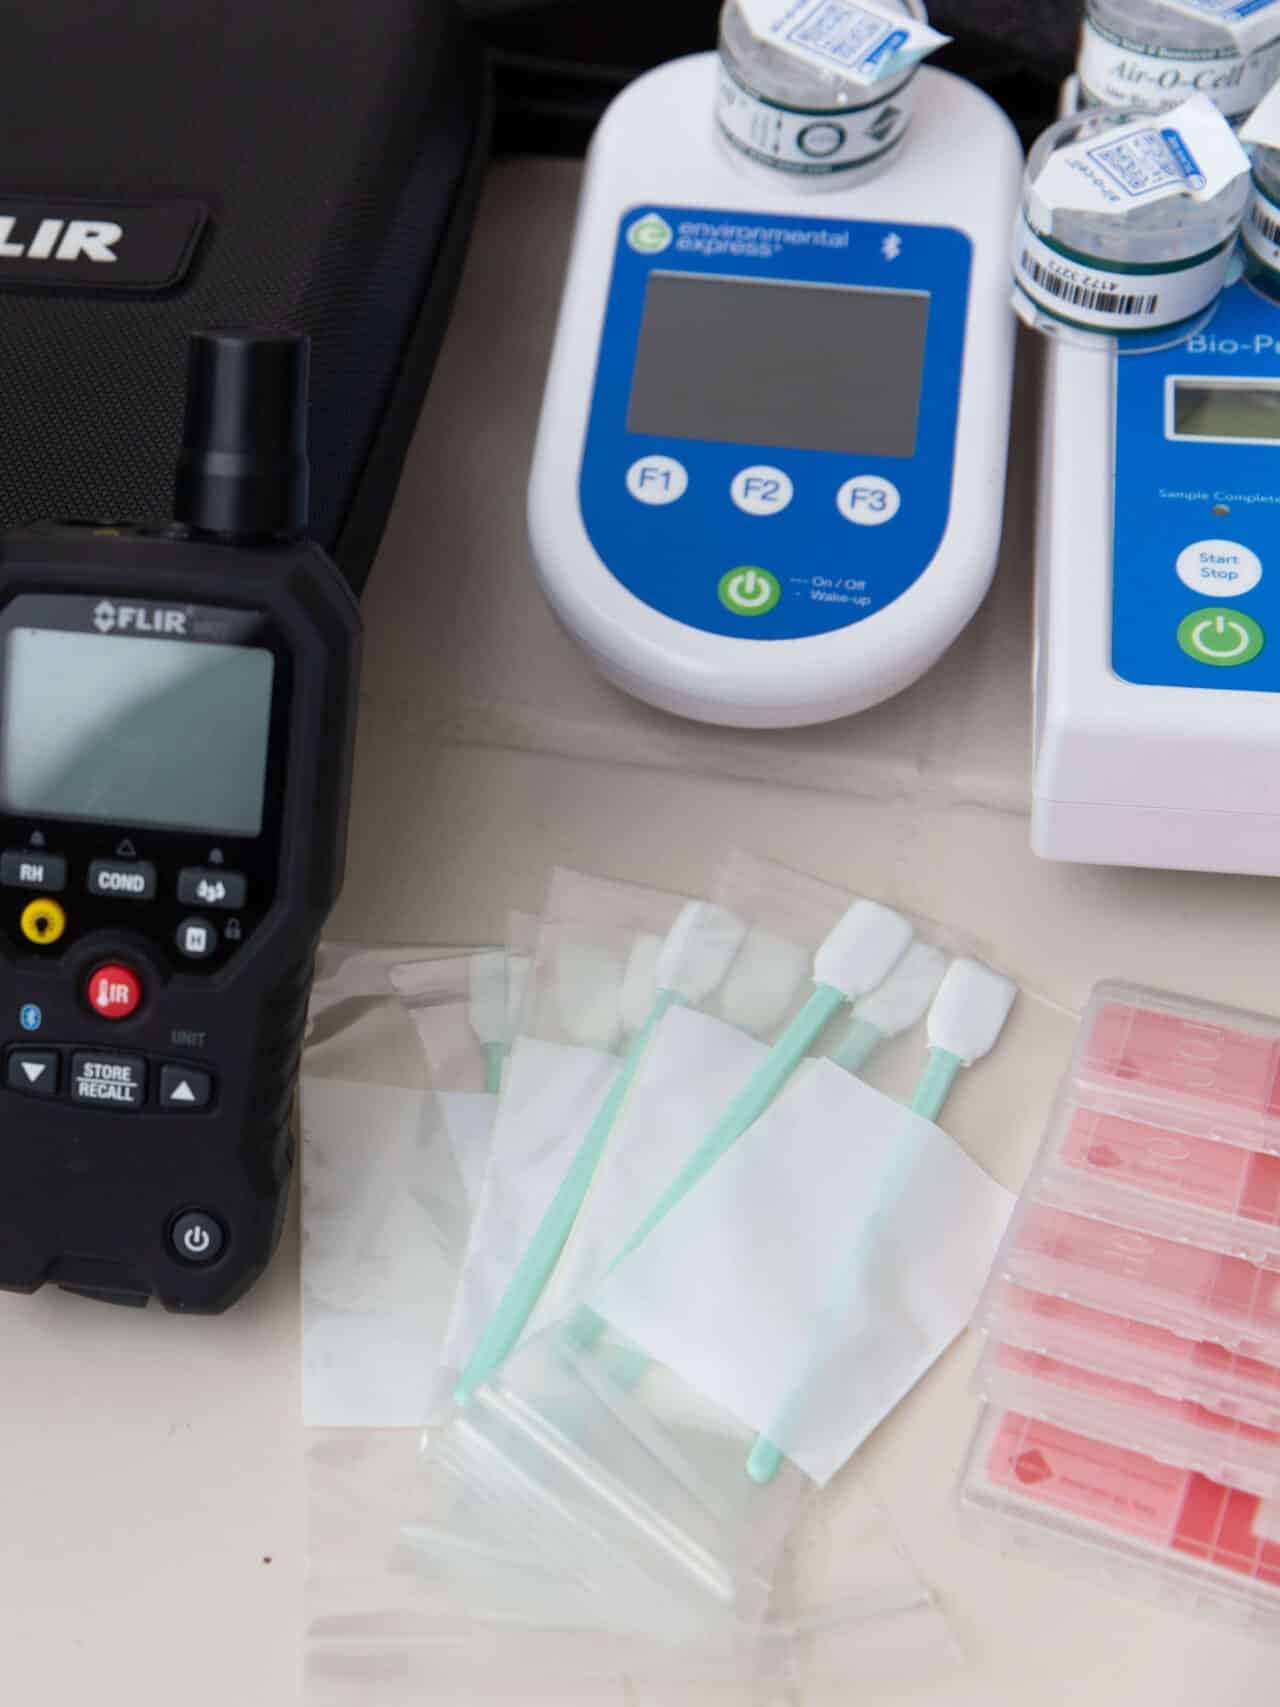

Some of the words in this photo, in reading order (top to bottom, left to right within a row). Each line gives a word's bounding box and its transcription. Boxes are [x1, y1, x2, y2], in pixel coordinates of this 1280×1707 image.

[677, 221, 850, 248] environmental
[638, 466, 673, 491] F1
[743, 478, 780, 501] F2
[1158, 488, 1209, 501] Sample
[850, 487, 888, 512] F3
[1199, 552, 1239, 566] Start
[812, 576, 833, 588] On
[1200, 567, 1240, 581] Stop
[811, 590, 872, 607] Wake-up
[117, 605, 187, 635] FLIR
[20, 864, 44, 883] RH
[98, 871, 145, 893] COND
[109, 983, 129, 1004] IR
[170, 1030, 207, 1049] UNIT
[83, 1061, 132, 1081] STORE
[78, 1083, 134, 1102] RECALL
